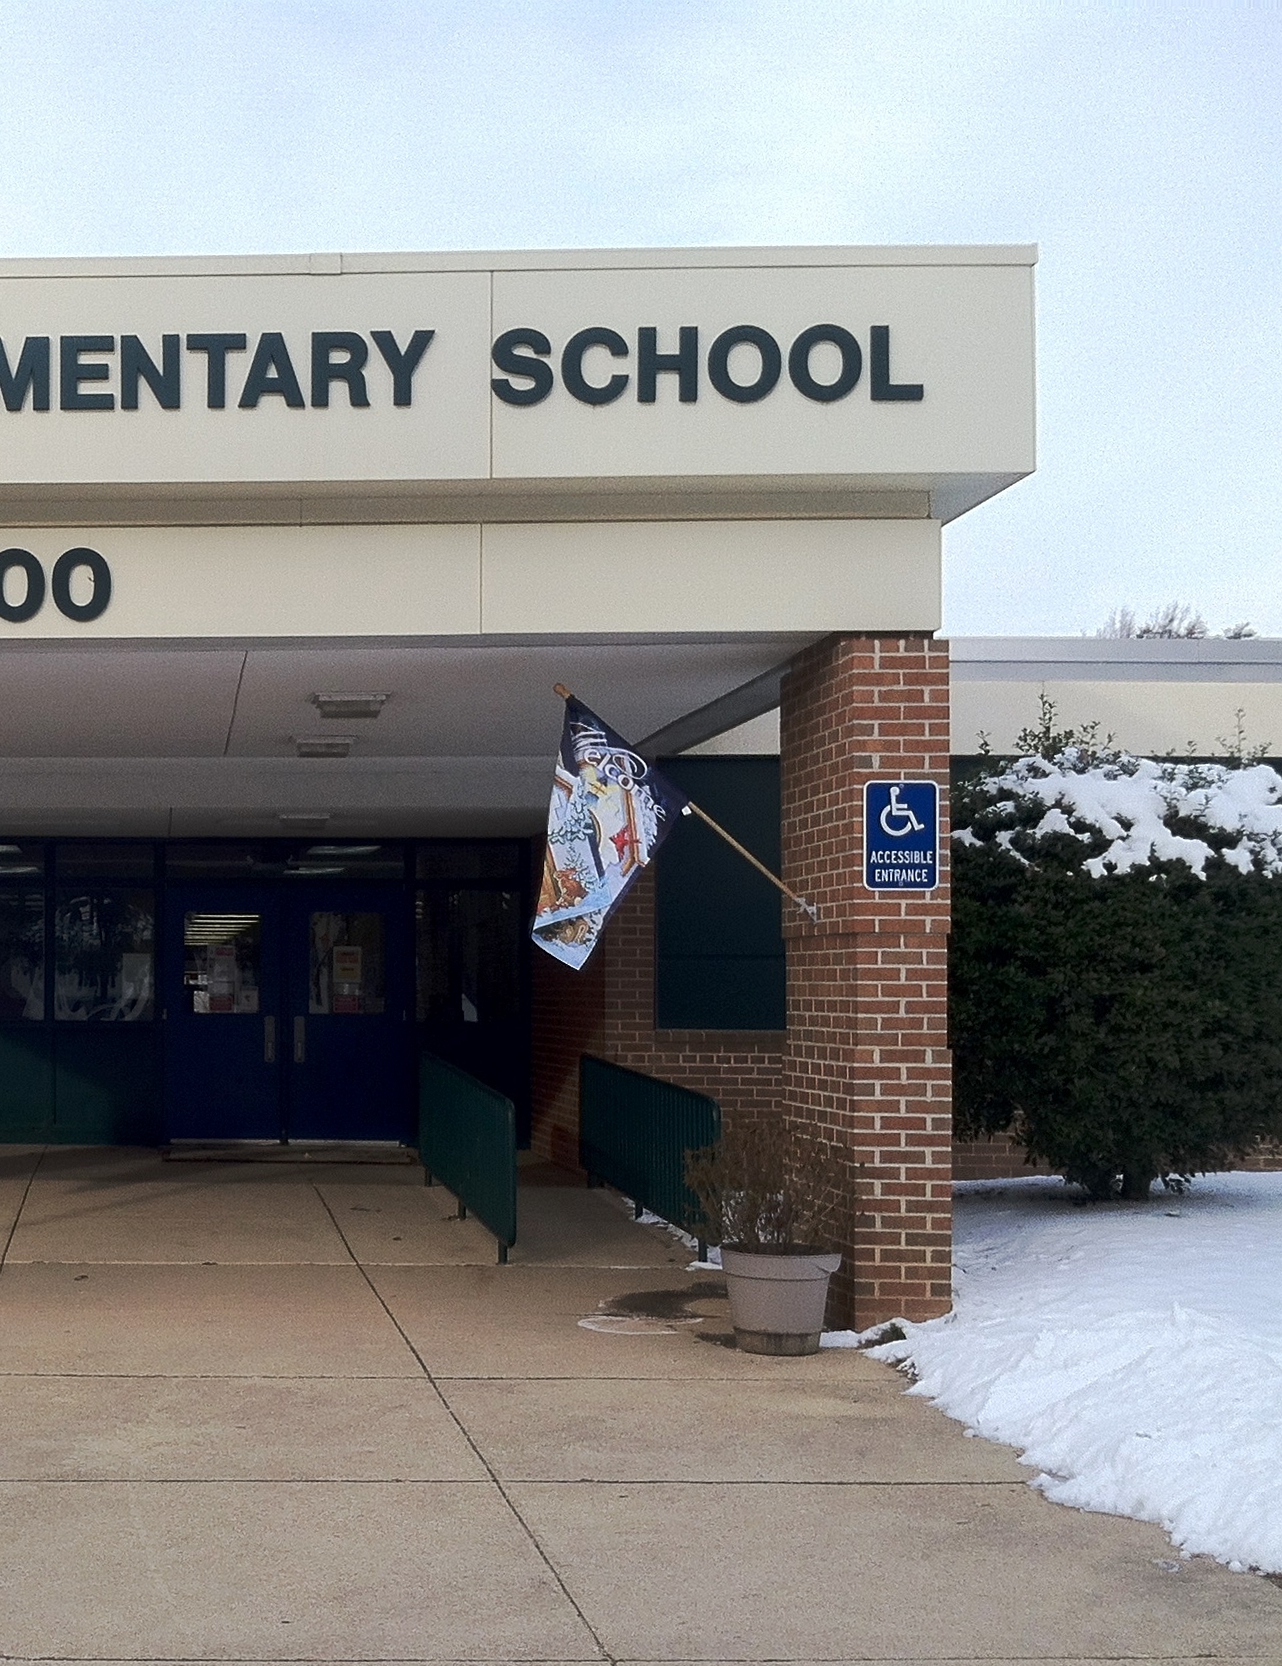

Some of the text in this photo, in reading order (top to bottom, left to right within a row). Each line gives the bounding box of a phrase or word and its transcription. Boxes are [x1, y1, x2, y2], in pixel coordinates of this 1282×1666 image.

[490, 323, 925, 408] SCHOOL
[870, 850, 933, 864] ACCESSIBLE
[875, 868, 928, 882] ENTRANCE
